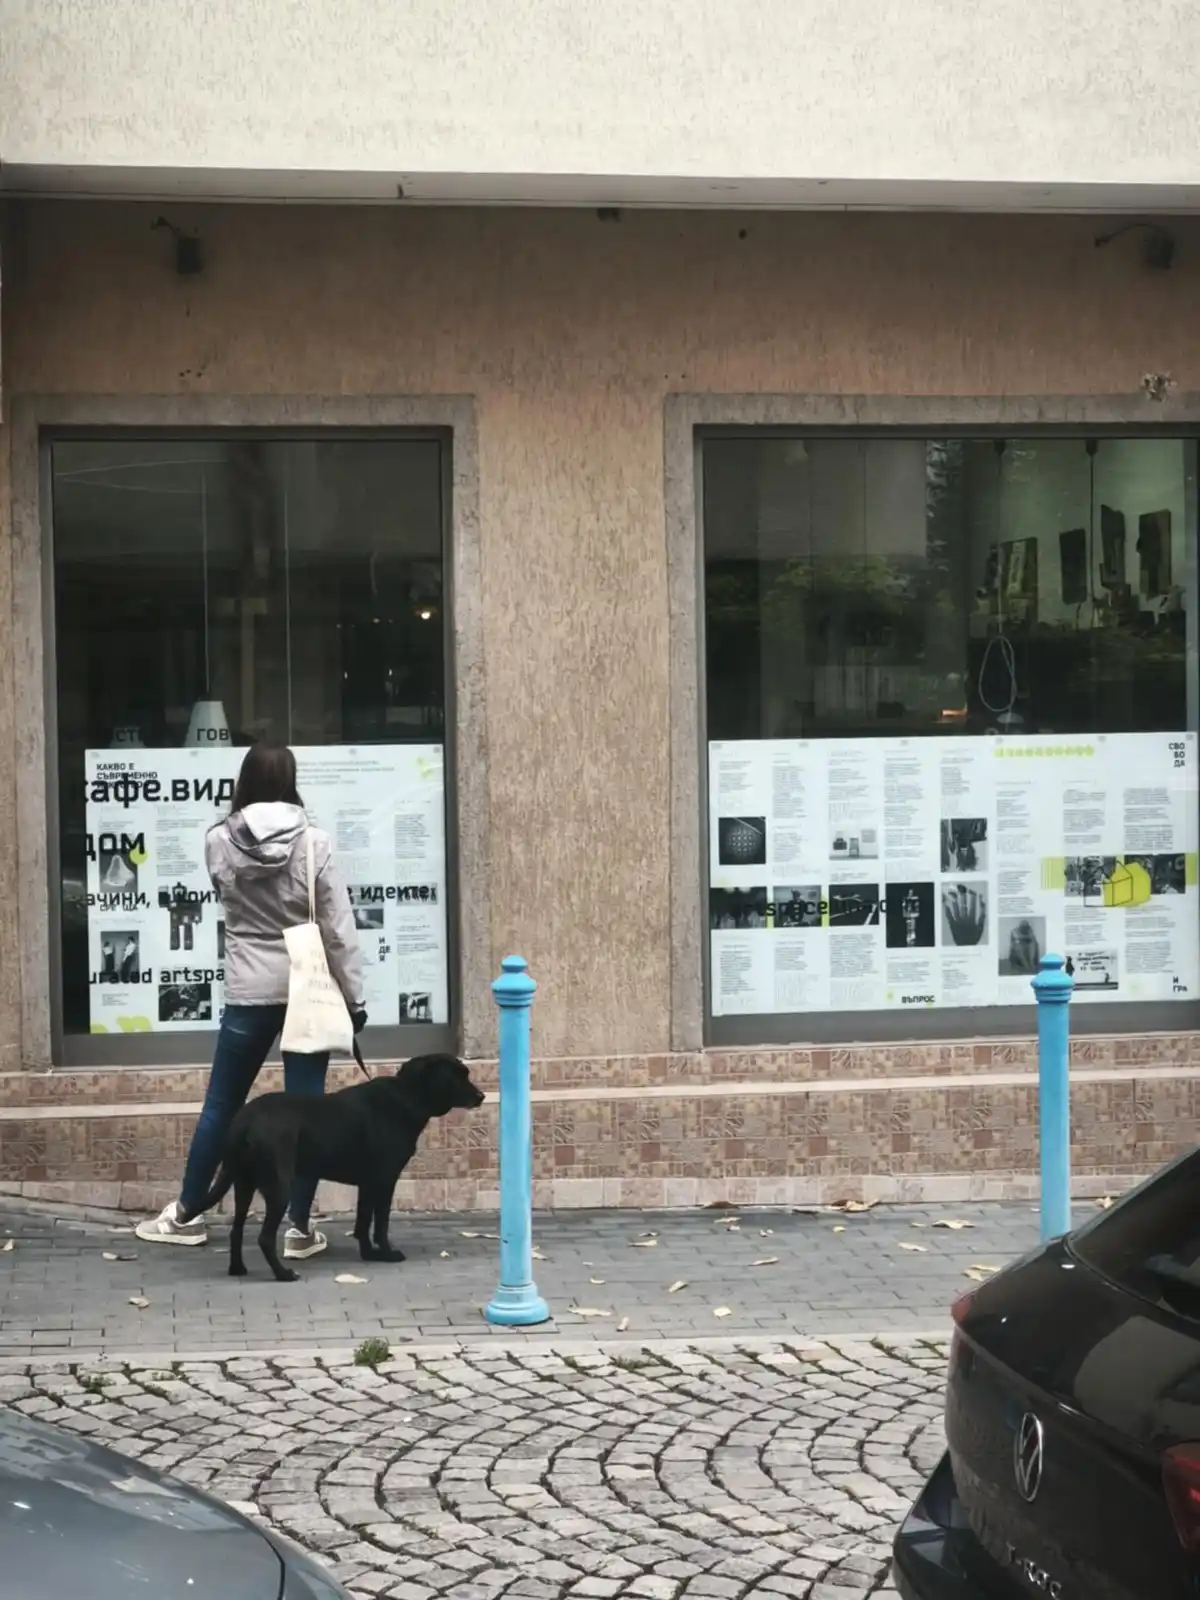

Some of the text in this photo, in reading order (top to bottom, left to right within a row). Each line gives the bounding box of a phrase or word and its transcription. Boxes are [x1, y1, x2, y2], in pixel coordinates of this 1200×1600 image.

[196, 728, 229, 741] ГОВ
[1168, 742, 1186, 750] СВО
[96, 763, 126, 771] КАКВО
[85, 773, 235, 808] афе.вид
[902, 995, 935, 1004] ВЪПРОС
